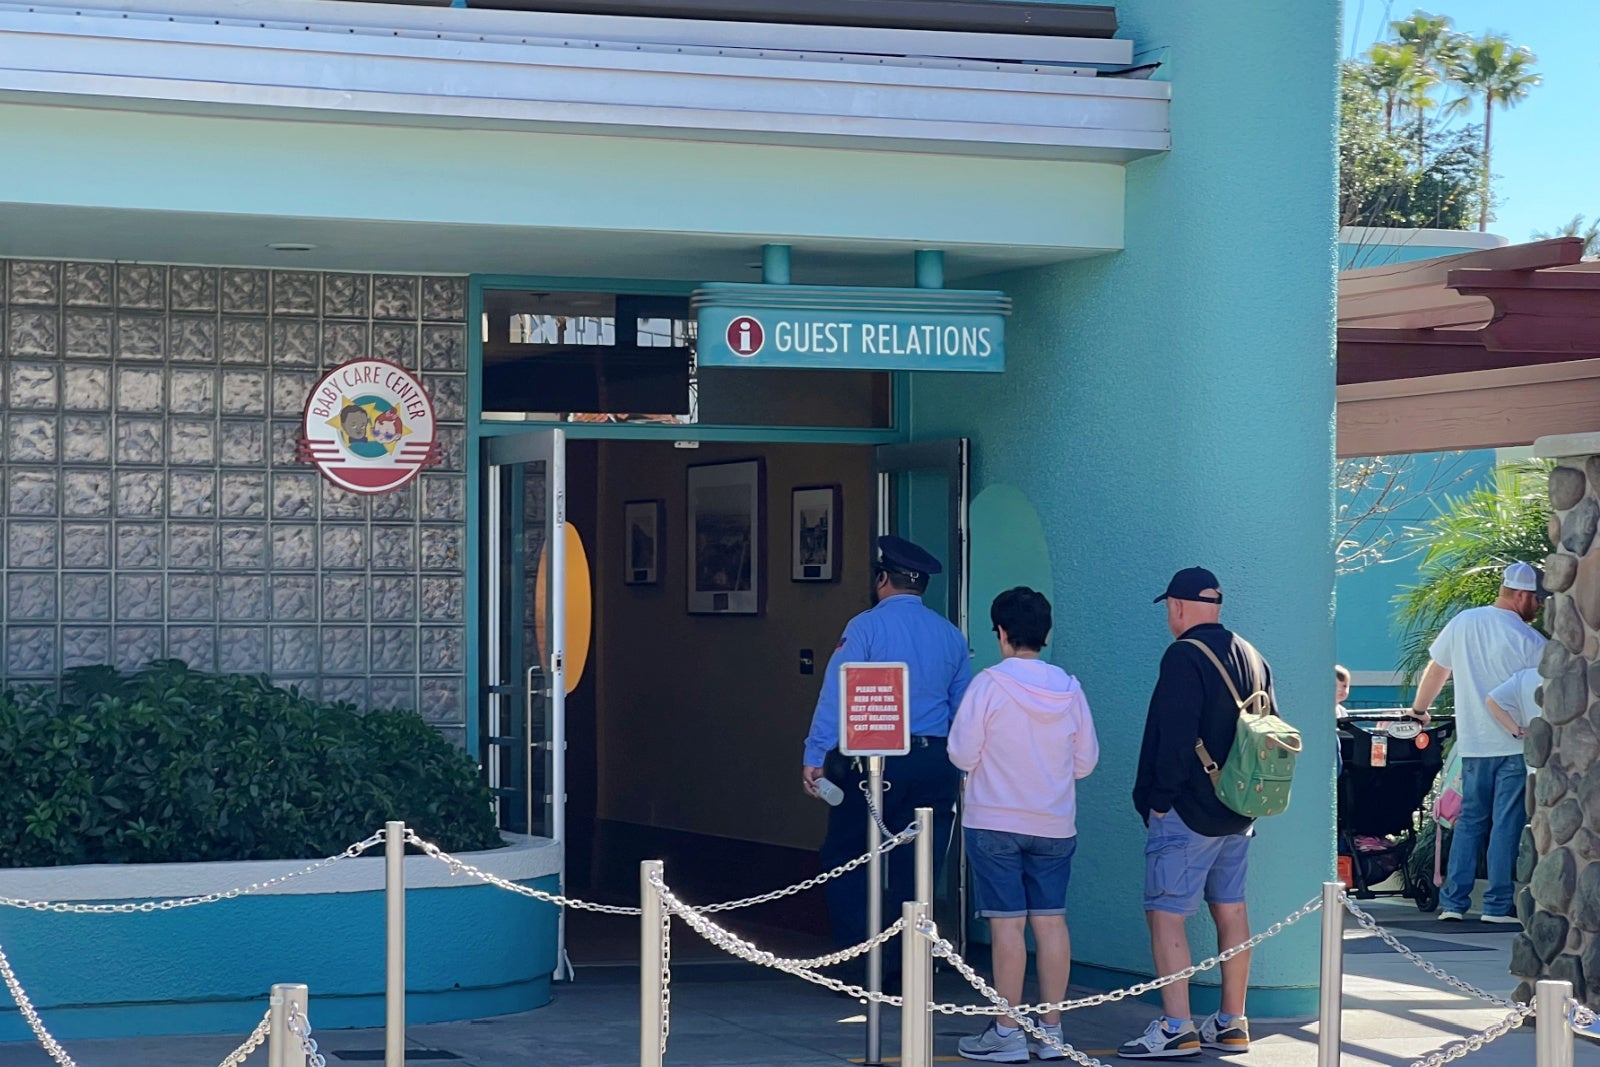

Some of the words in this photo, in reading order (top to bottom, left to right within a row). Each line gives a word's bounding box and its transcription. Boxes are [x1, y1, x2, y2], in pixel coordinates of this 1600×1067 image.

[775, 321, 852, 353] GUEST
[862, 323, 992, 357] RELATIONS
[312, 378, 343, 418] BABY
[343, 366, 382, 387] CARE
[385, 371, 426, 420] CENTER
